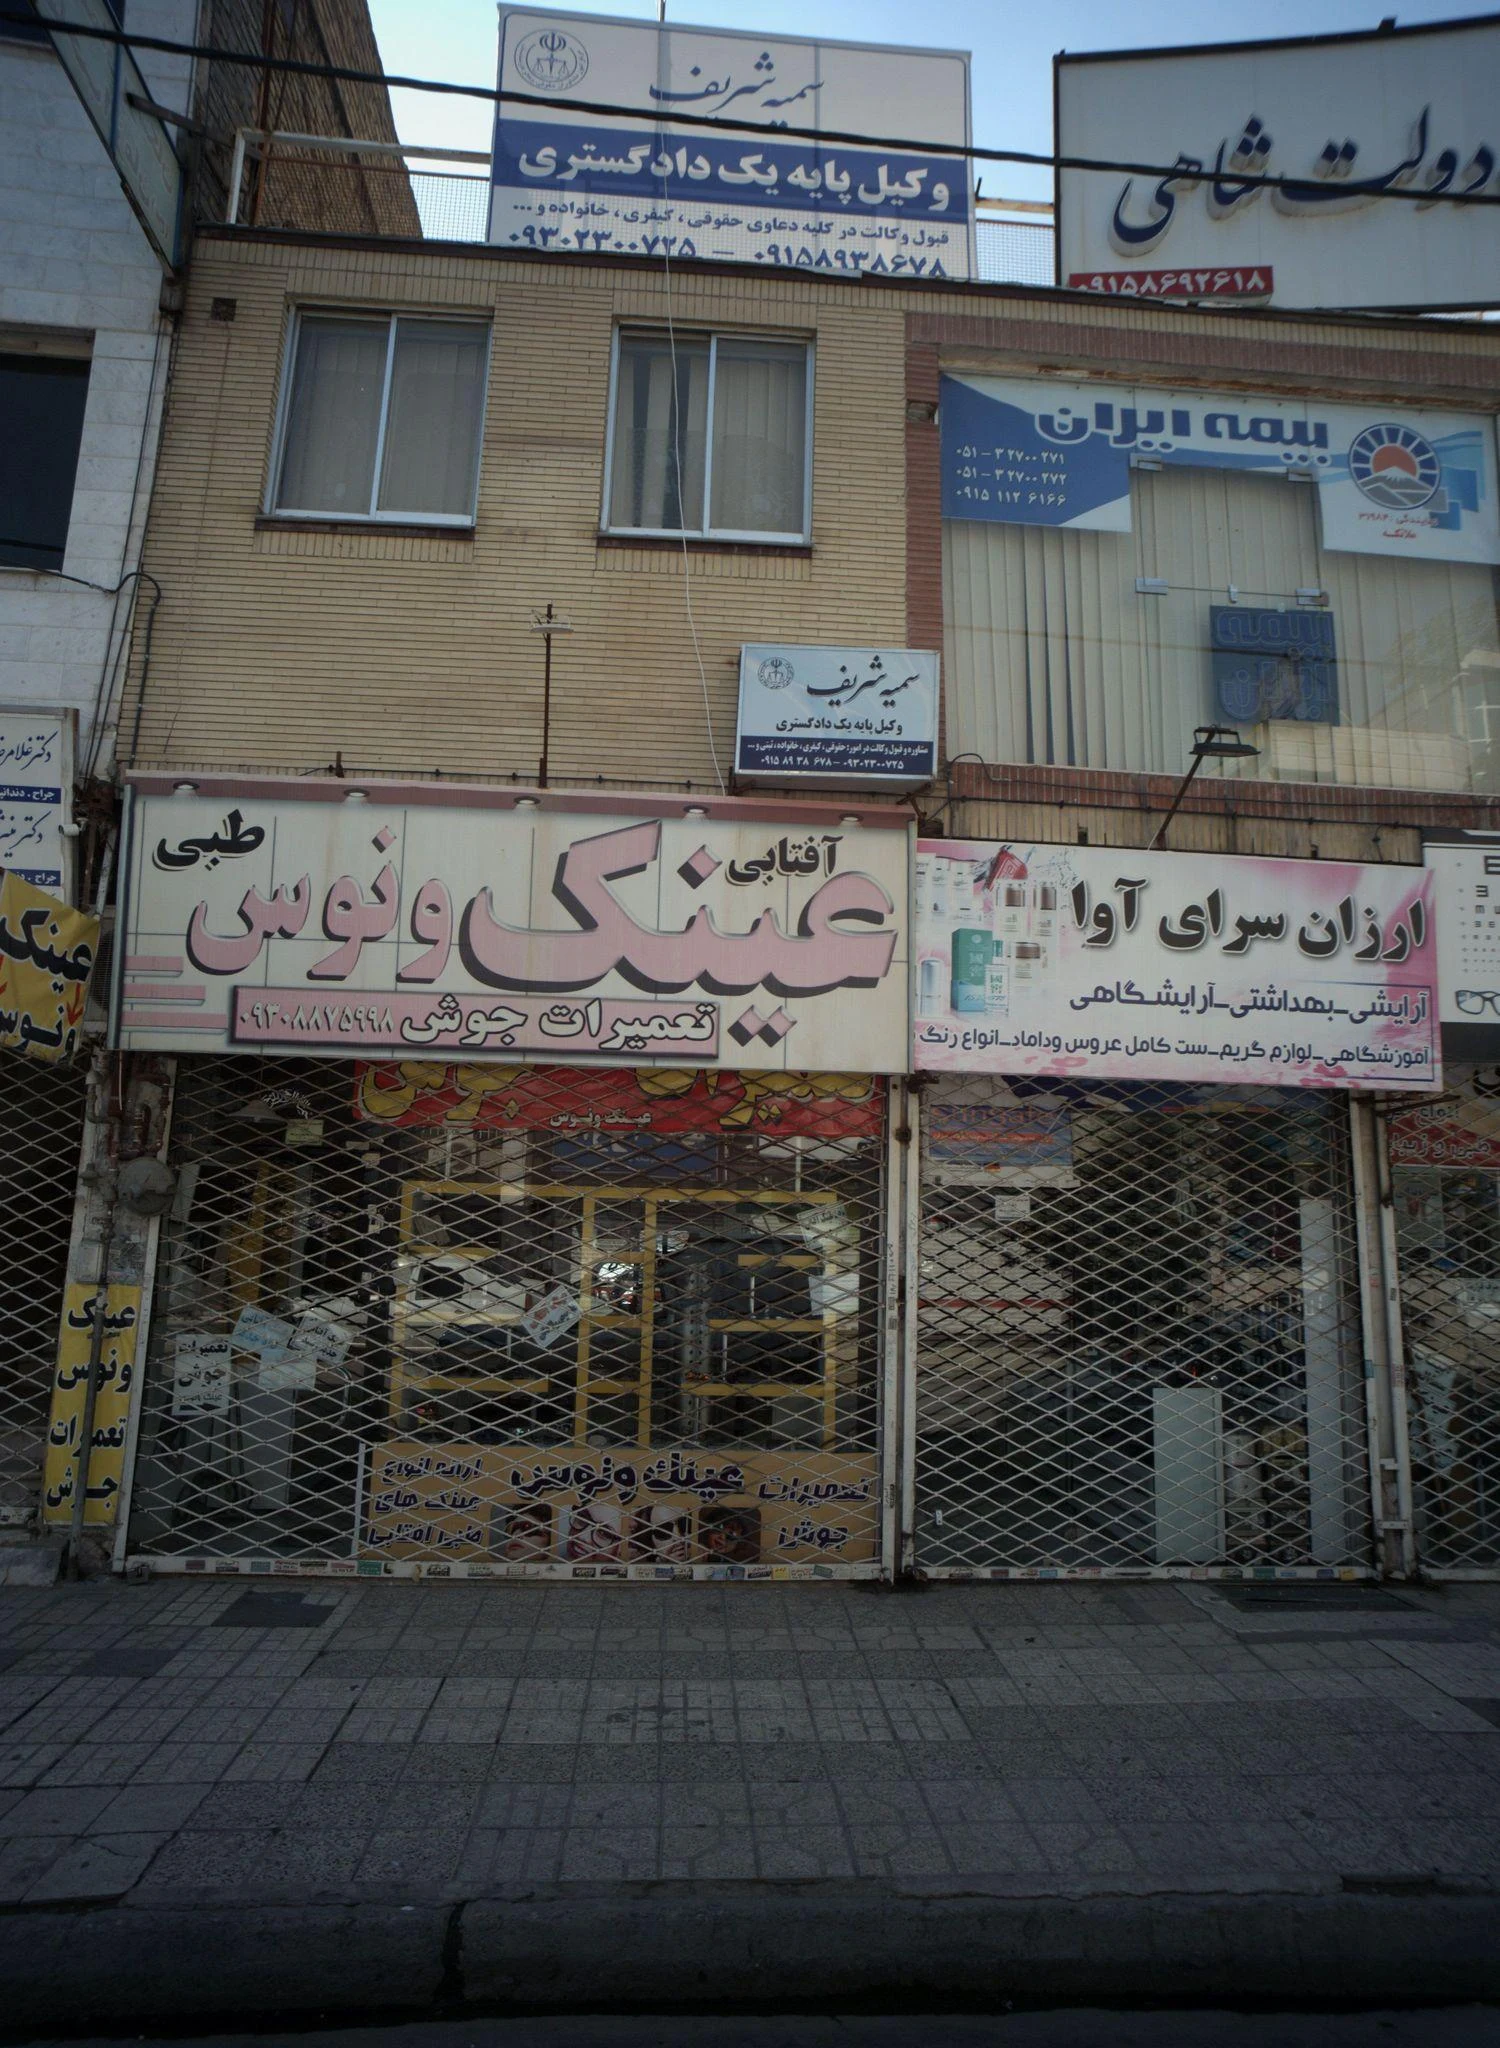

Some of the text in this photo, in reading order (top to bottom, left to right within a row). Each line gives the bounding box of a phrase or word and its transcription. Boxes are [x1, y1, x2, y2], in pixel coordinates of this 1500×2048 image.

[518, 144, 950, 211] وکیل پایه یک دادگستری
[549, 202, 610, 220] خانواده
[747, 217, 799, 234] دعاوی
[802, 222, 835, 238] کلیه
[838, 226, 858, 241] در
[861, 225, 910, 246] وکالت
[912, 230, 950, 248] قبول
[1033, 400, 1333, 468] بیمه ایران
[956, 485, 990, 501] ۰۹۱۵
[1028, 491, 1067, 506] ۶۱۶۶
[806, 654, 921, 708] سمیه شریف
[775, 716, 903, 735] وکیل پایه یک دادگستری
[20, 730, 59, 771] دکتر
[32, 789, 55, 801] جراح
[9, 810, 52, 850] دکتر
[153, 808, 265, 871] طبی
[725, 835, 843, 887] آفتابی
[1072, 877, 1148, 947] آوا
[1159, 887, 1285, 953] سرای
[1299, 895, 1425, 961] ارزان
[186, 818, 899, 1047] عینک ونوس
[401, 993, 528, 1046] جوش
[538, 997, 716, 1050] تعمیرات
[919, 1025, 958, 1048] رنگ
[1065, 1036, 1122, 1055] عروس
[1126, 1035, 1172, 1056] کامل
[550, 1107, 652, 1128] عینک ونوس
[49, 1415, 127, 1457] تعمات
[46, 1466, 119, 1508] جش
[510, 1451, 745, 1505] عینک ونوس
[757, 1476, 873, 1509] تعمیرات
[776, 1516, 848, 1551] جوش
